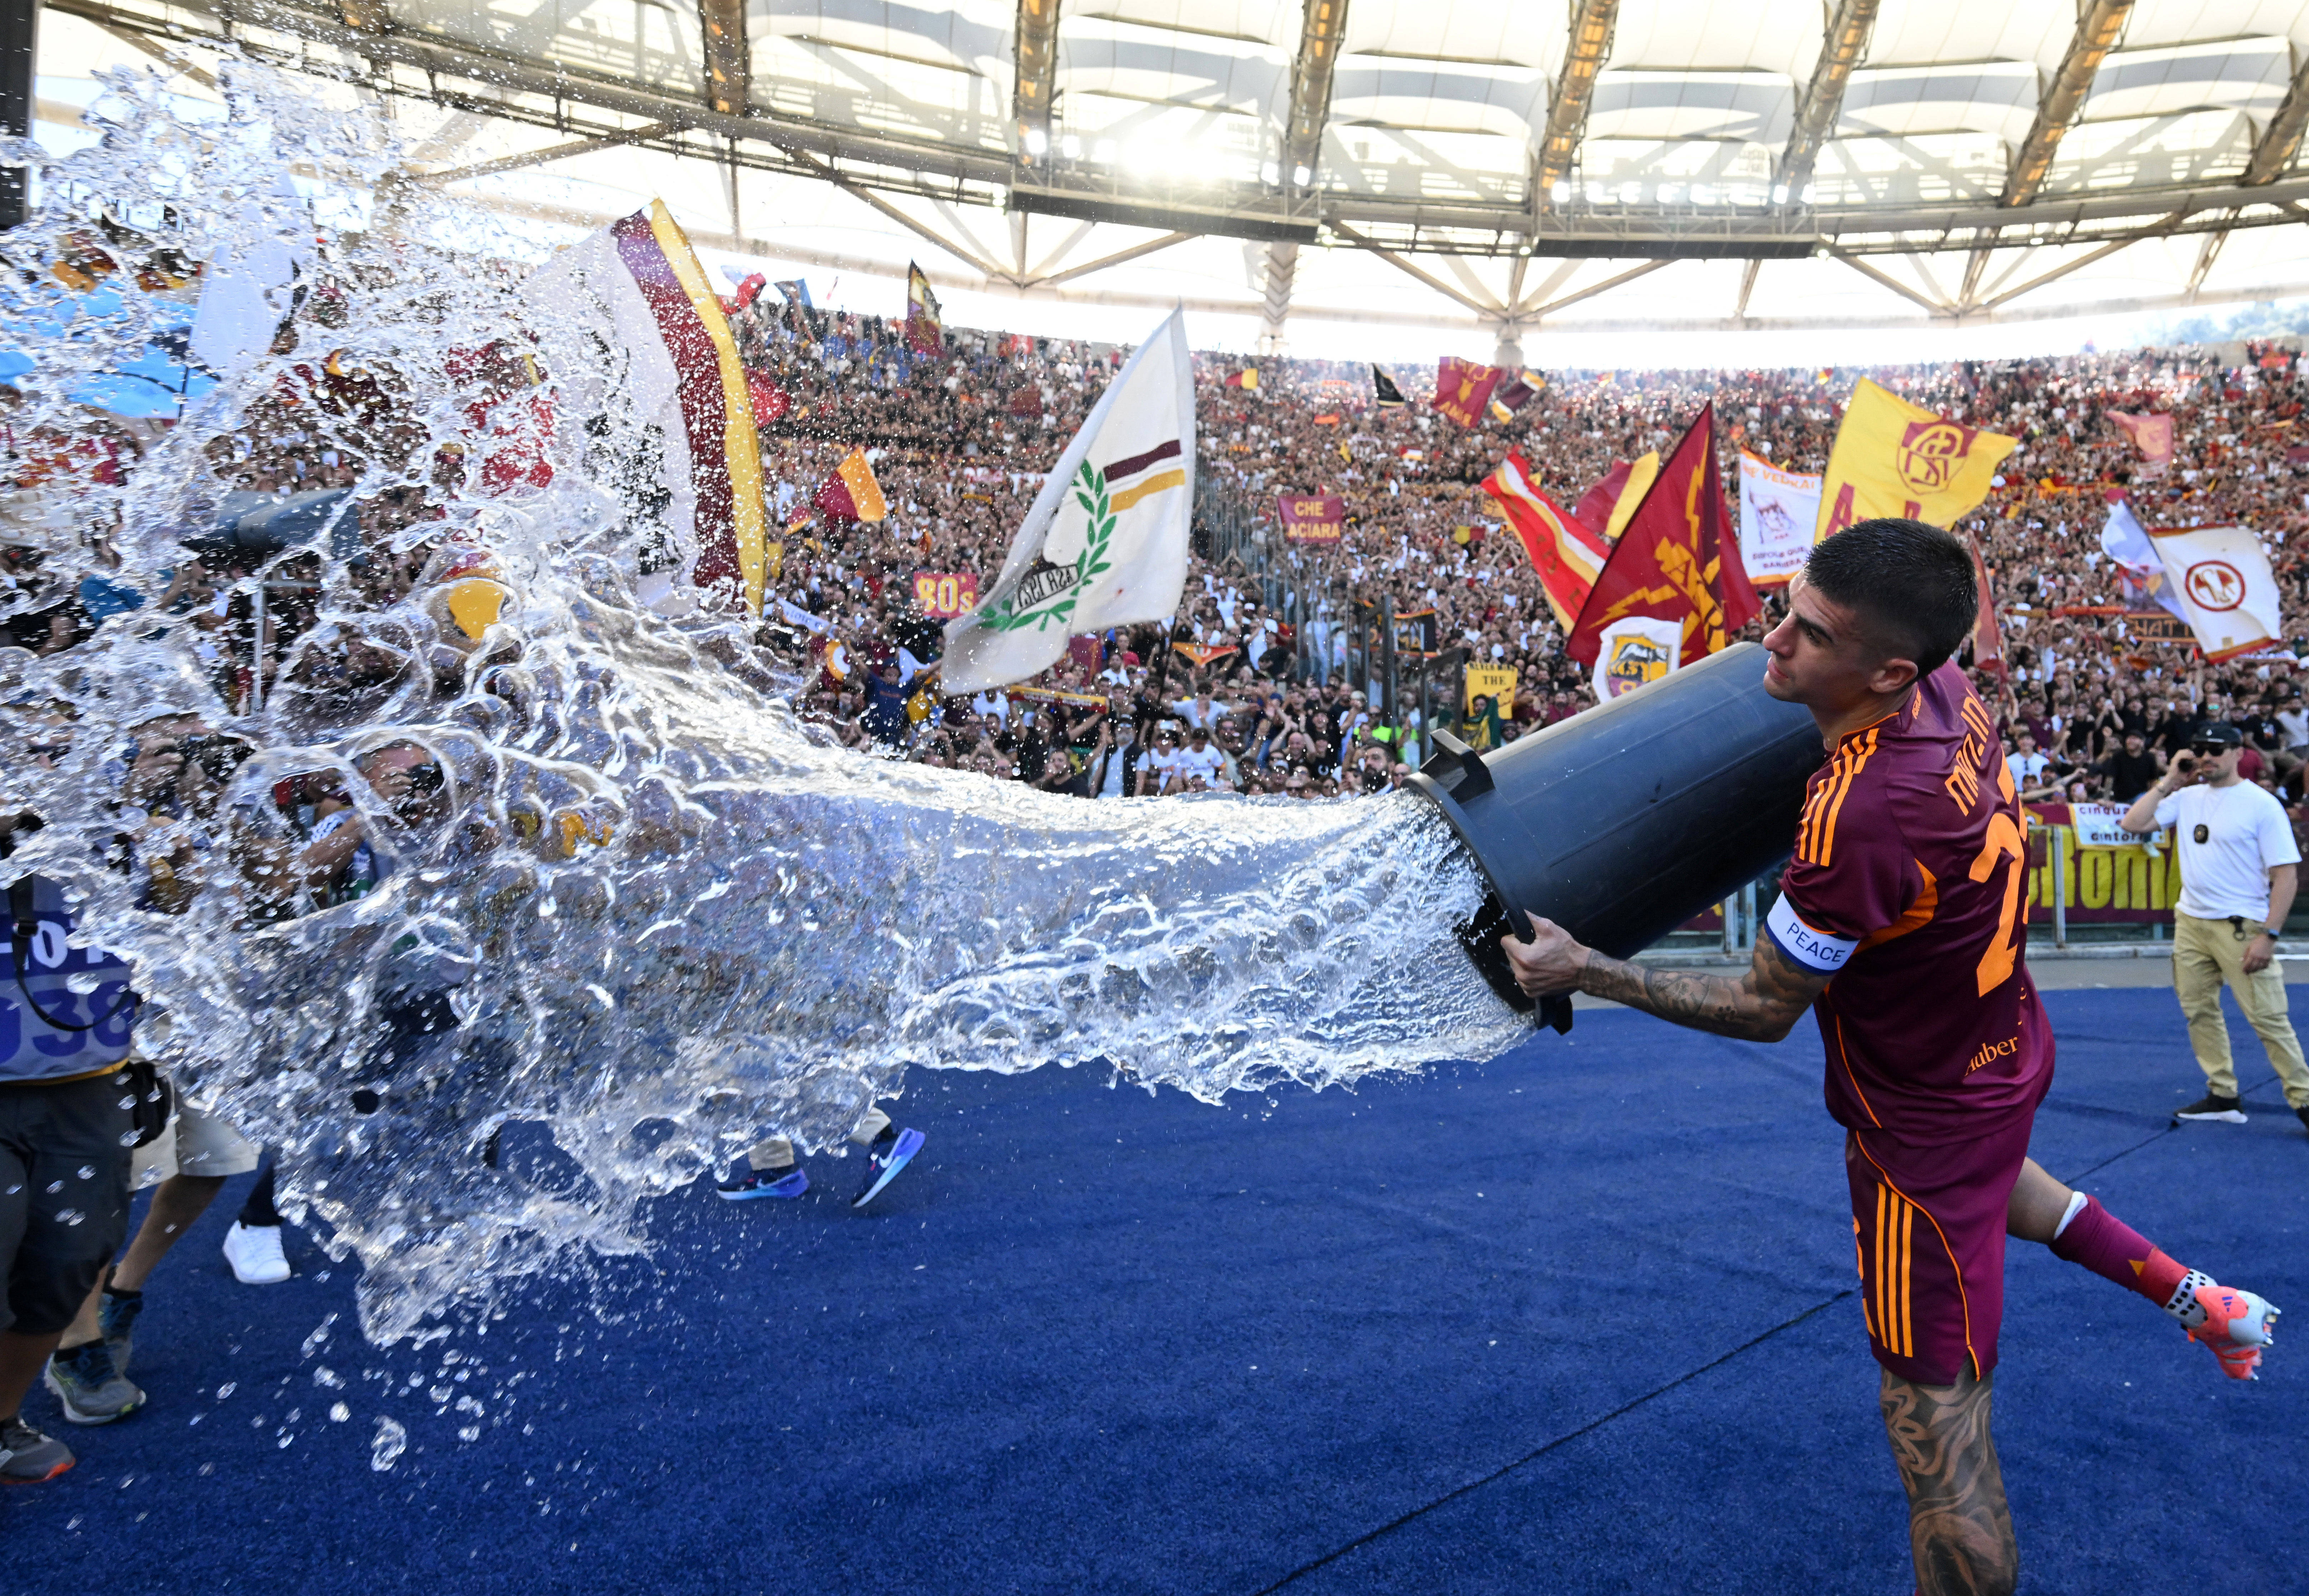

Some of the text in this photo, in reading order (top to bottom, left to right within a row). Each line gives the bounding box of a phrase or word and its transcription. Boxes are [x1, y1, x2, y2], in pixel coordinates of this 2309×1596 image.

[1294, 501, 1324, 517] CHE
[916, 576, 974, 614] 80's
[1483, 676, 1506, 685] THE
[1787, 922, 1845, 962] PEACE
